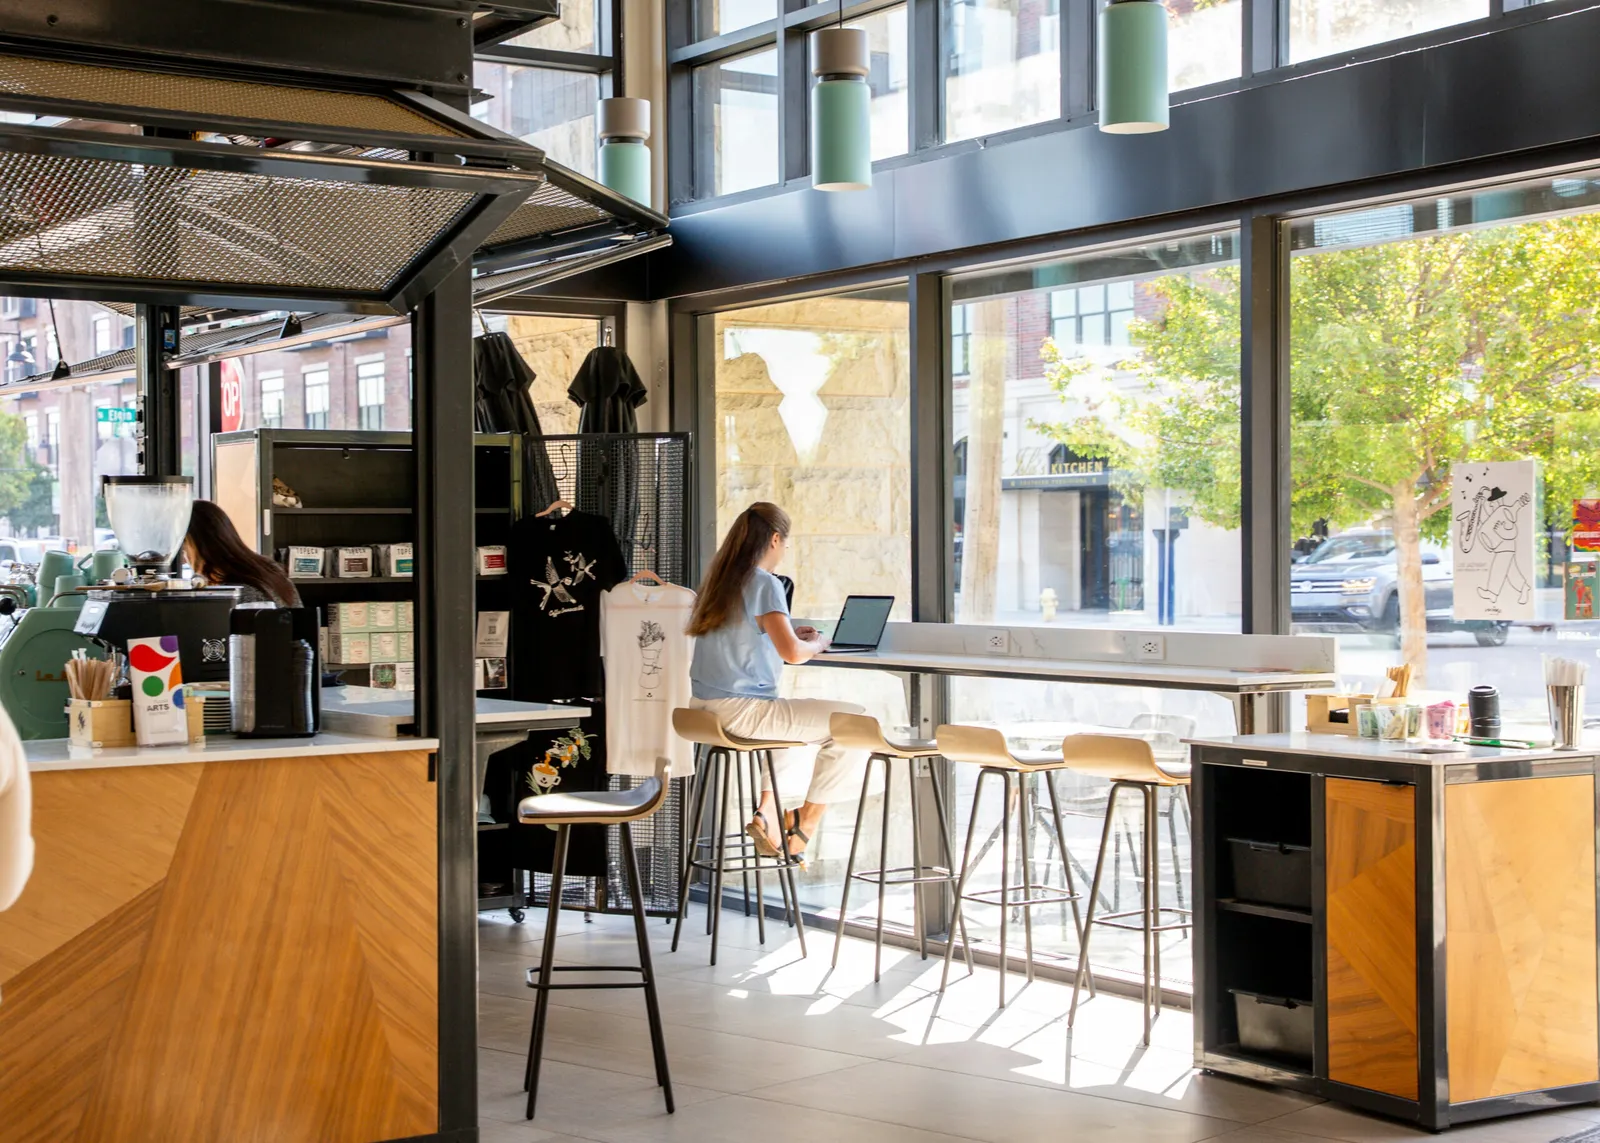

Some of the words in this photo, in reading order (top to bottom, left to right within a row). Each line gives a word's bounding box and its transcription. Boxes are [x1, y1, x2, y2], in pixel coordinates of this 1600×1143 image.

[221, 381, 239, 417] OP
[108, 409, 132, 422] Elgin
[1051, 461, 1103, 474] KITCHEN
[295, 547, 318, 555] TOPECA
[147, 703, 170, 712] ARTS
